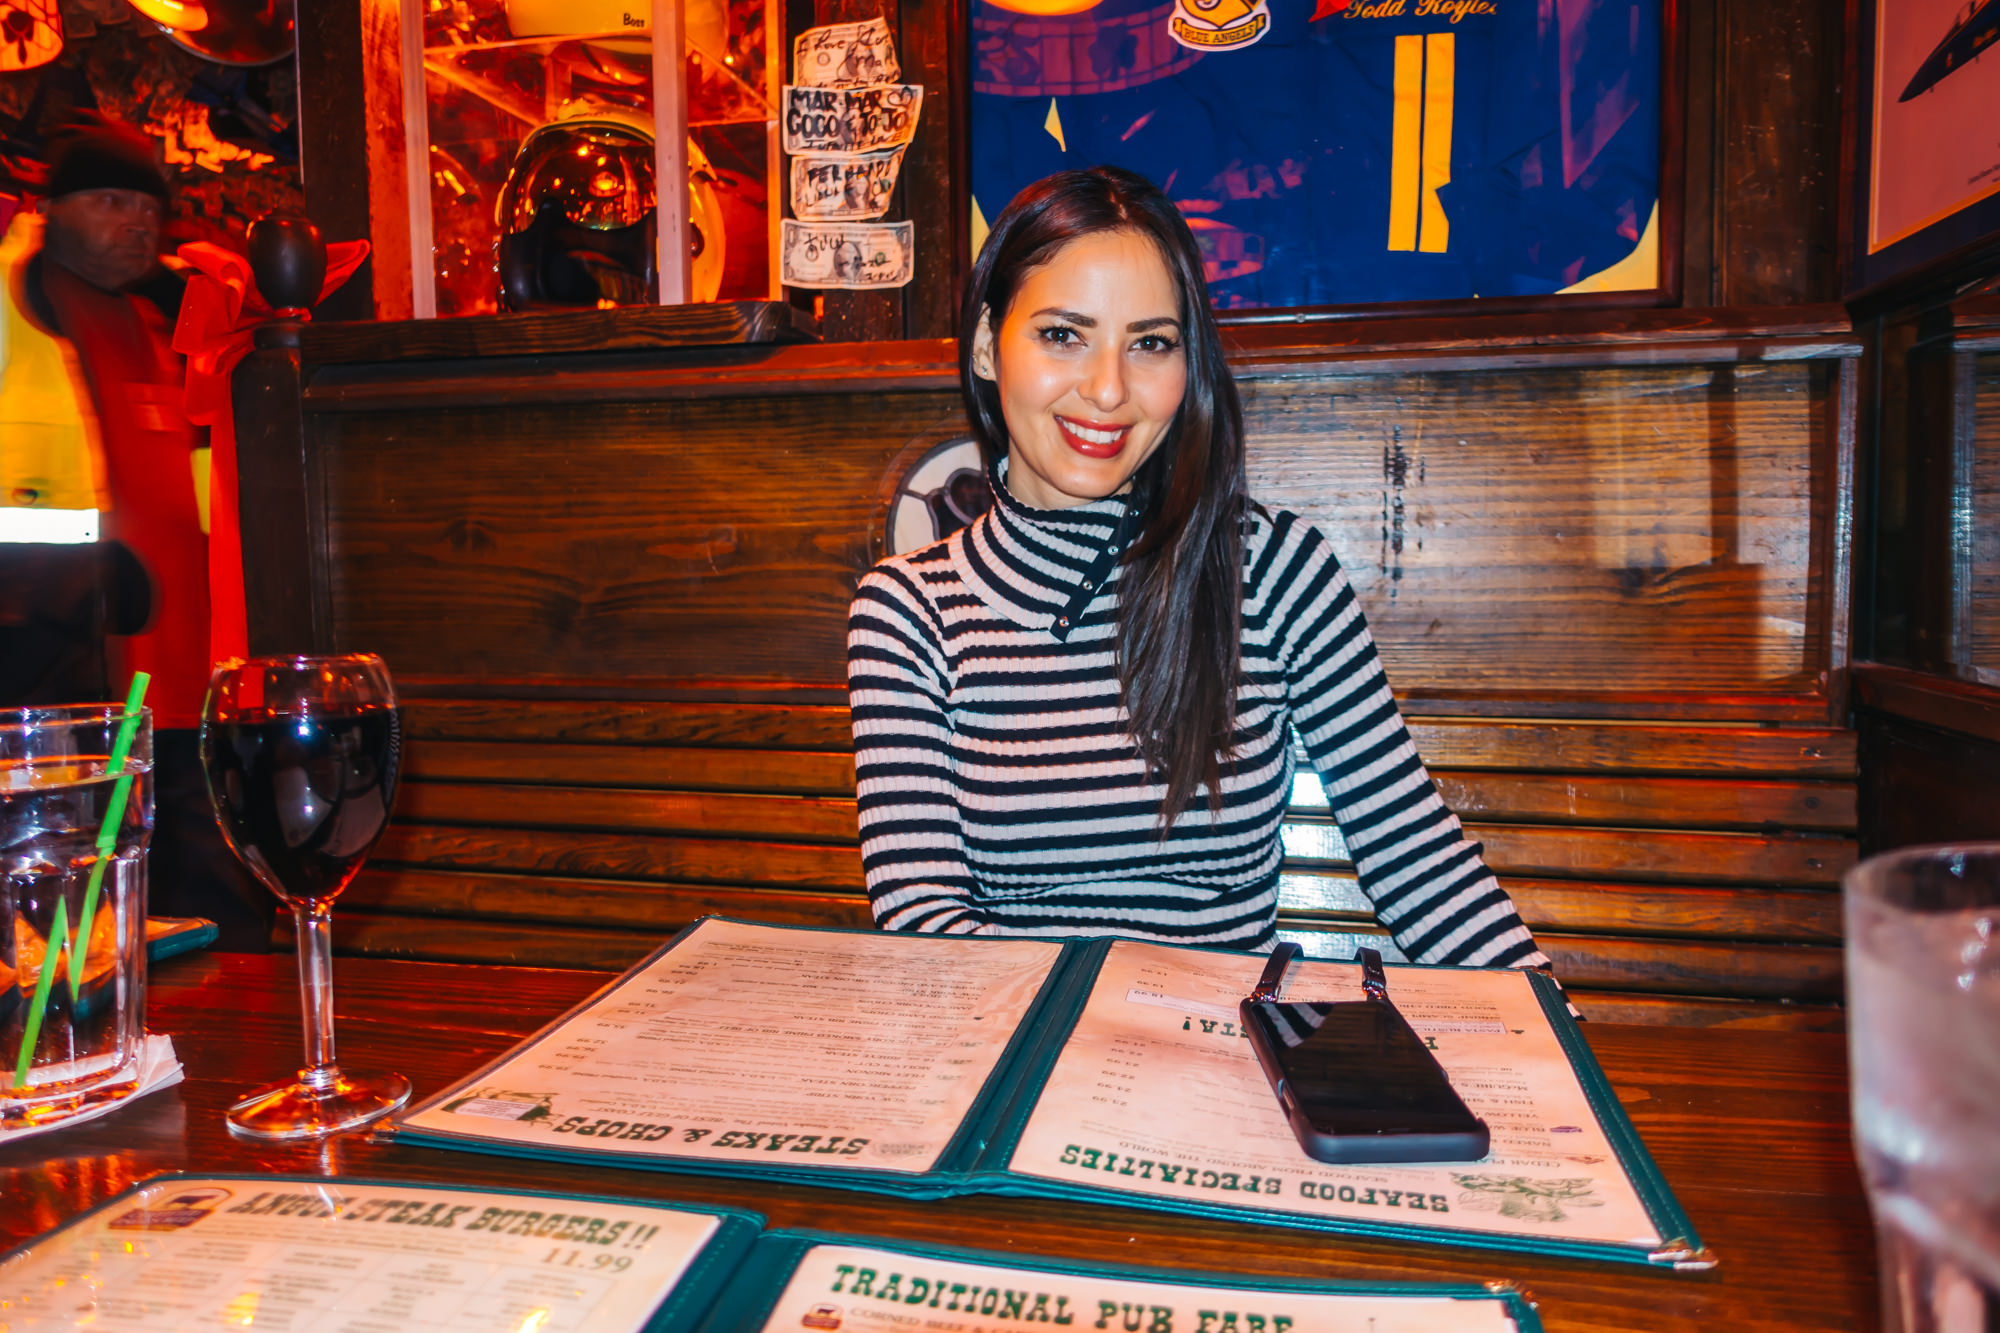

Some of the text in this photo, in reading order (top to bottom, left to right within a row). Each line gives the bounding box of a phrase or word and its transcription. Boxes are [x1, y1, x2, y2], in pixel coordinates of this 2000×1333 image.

[1182, 22, 1256, 44] BLUE ANGELS
[552, 1116, 673, 1142] CHOPS
[683, 1129, 712, 1143] &
[712, 1130, 871, 1155] STEAKS
[1059, 1144, 1449, 1213] SEAFOOD SPECIALTIES
[343, 1198, 475, 1230] STEAK
[541, 1248, 634, 1274] 11.99
[831, 1264, 1074, 1325] TRADITIONAL
[1095, 1300, 1173, 1333] PUB
